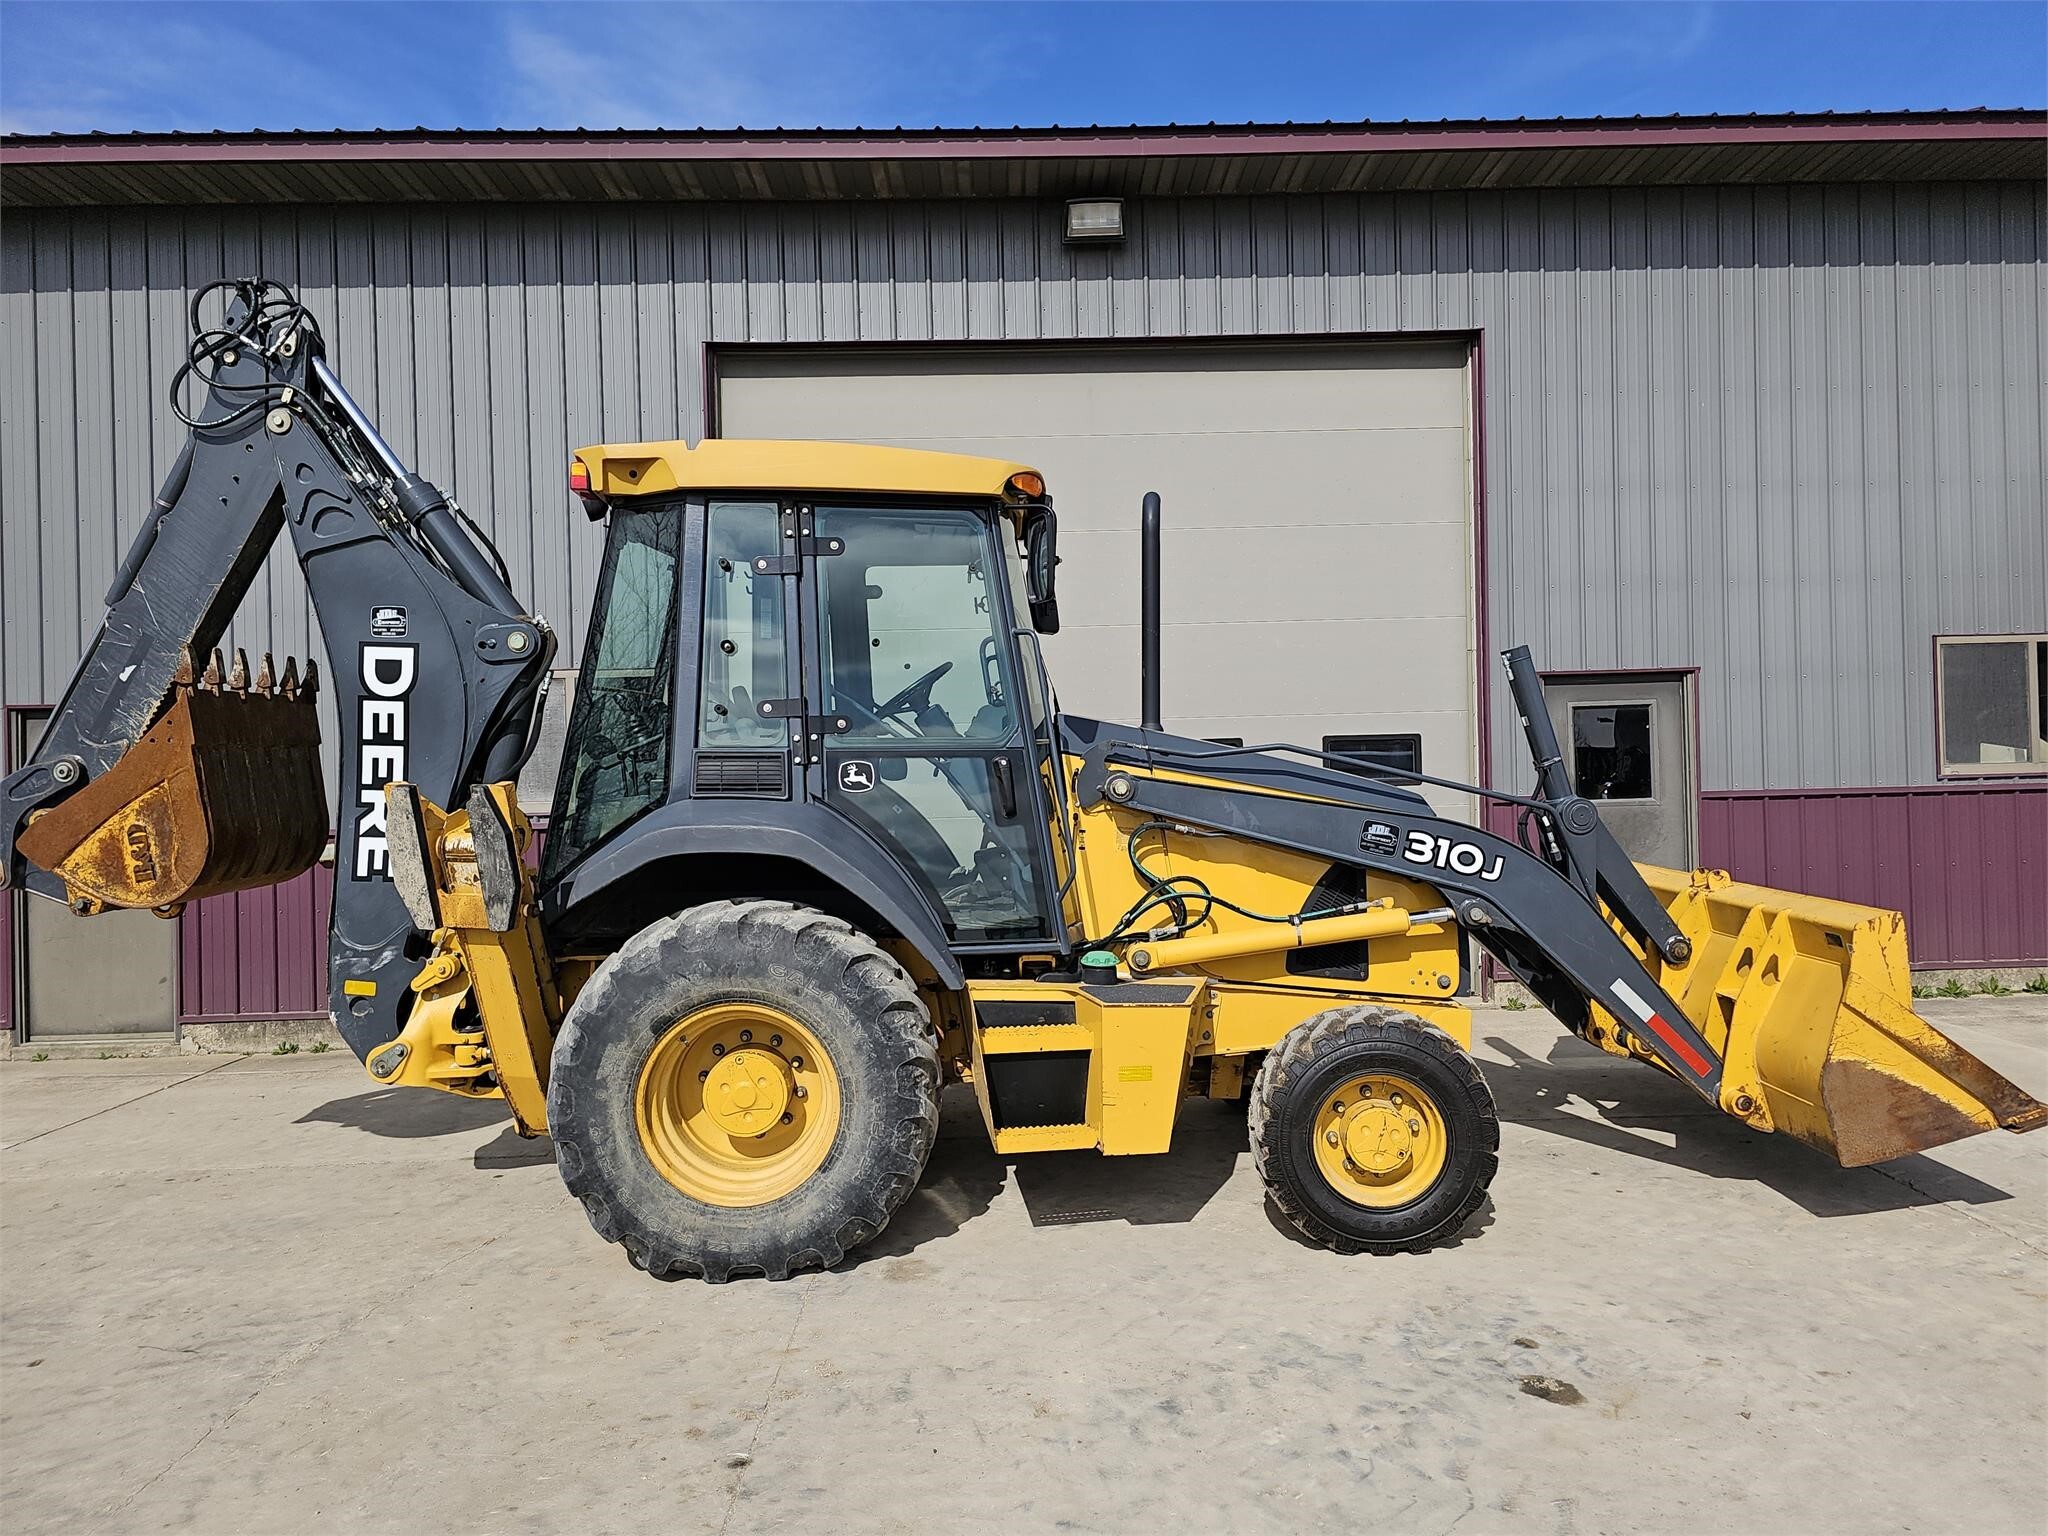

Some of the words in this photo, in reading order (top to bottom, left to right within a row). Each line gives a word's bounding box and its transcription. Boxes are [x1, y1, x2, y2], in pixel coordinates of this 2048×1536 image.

[355, 644, 417, 880] DEERE
[1403, 831, 1506, 882] 310J
[767, 962, 869, 1038] GALAXY
[616, 1187, 694, 1246] RIDER
